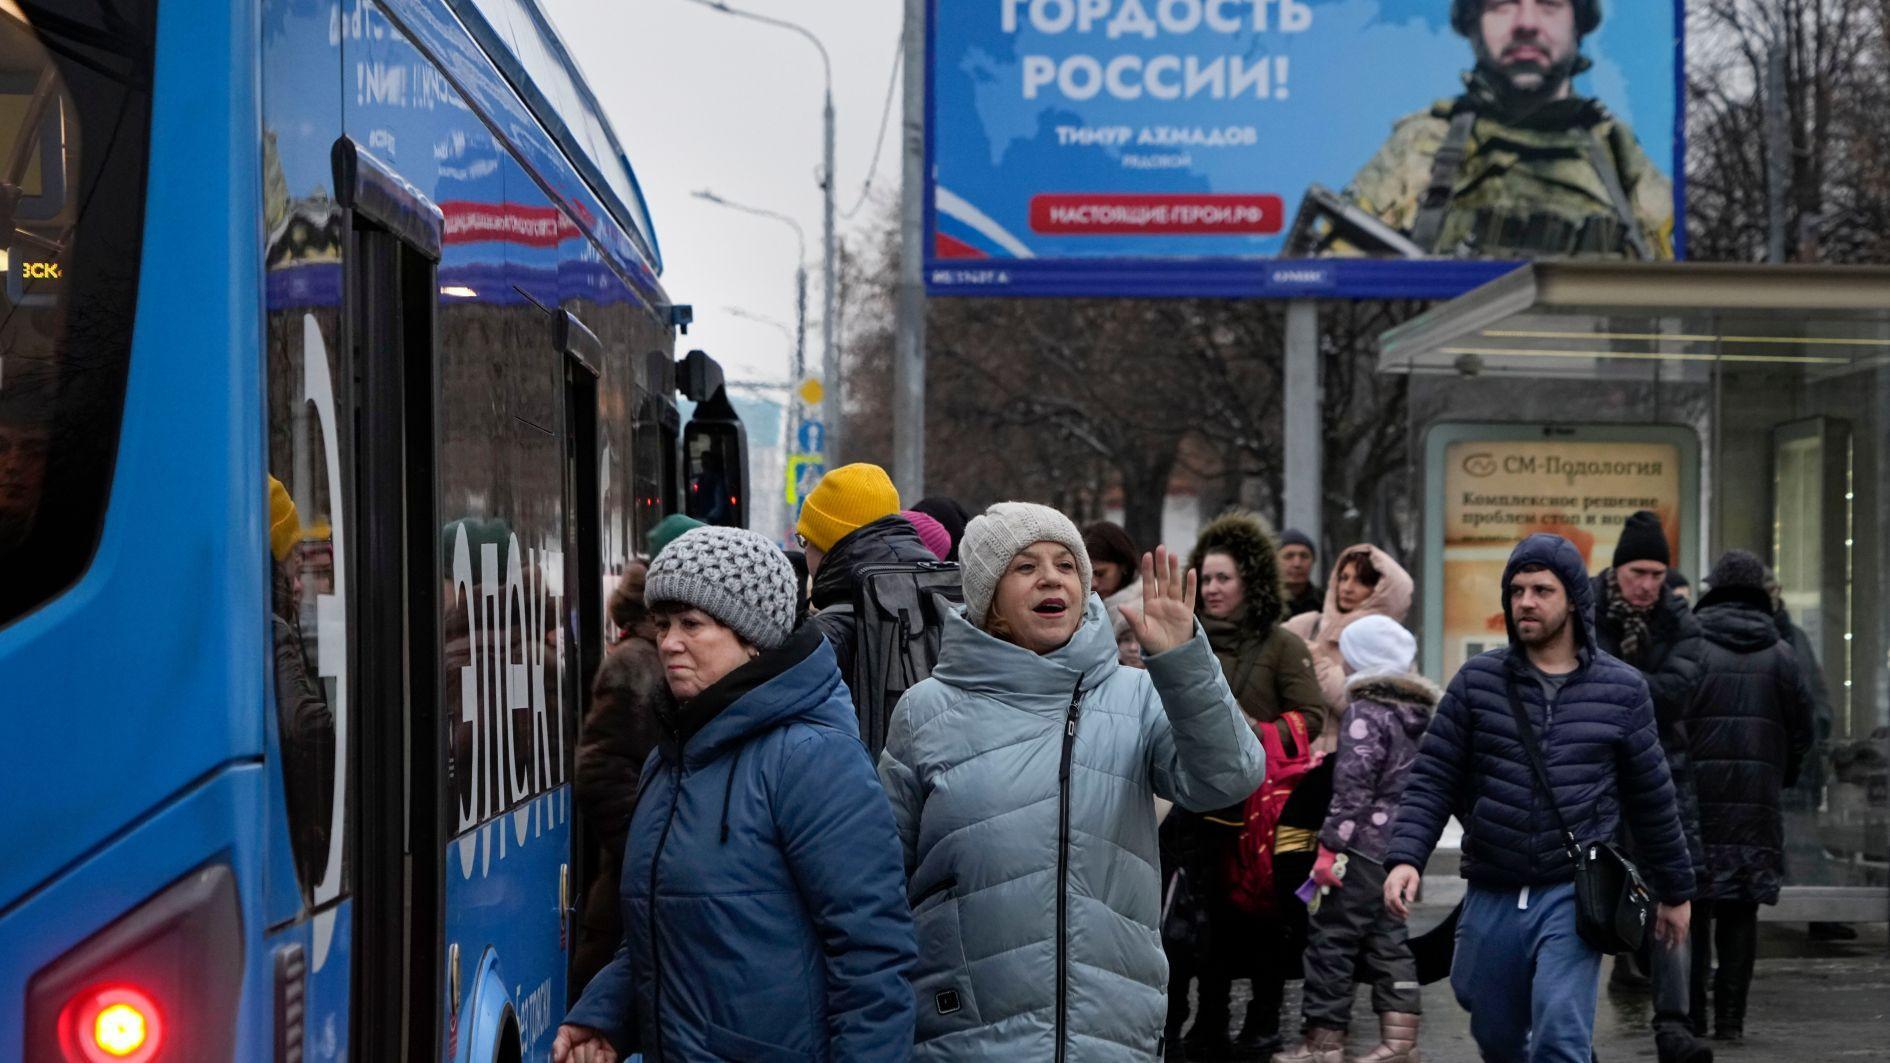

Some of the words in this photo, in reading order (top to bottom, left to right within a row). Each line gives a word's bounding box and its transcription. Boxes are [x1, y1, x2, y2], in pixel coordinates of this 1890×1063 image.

[1001, 0, 1312, 38] ГОРДОСТЬ
[1022, 55, 1289, 100] РОССИИ!
[1055, 126, 1131, 145] ТИМУР
[1137, 126, 1257, 146] АХМАДОВ
[1462, 509, 1536, 526] проблем
